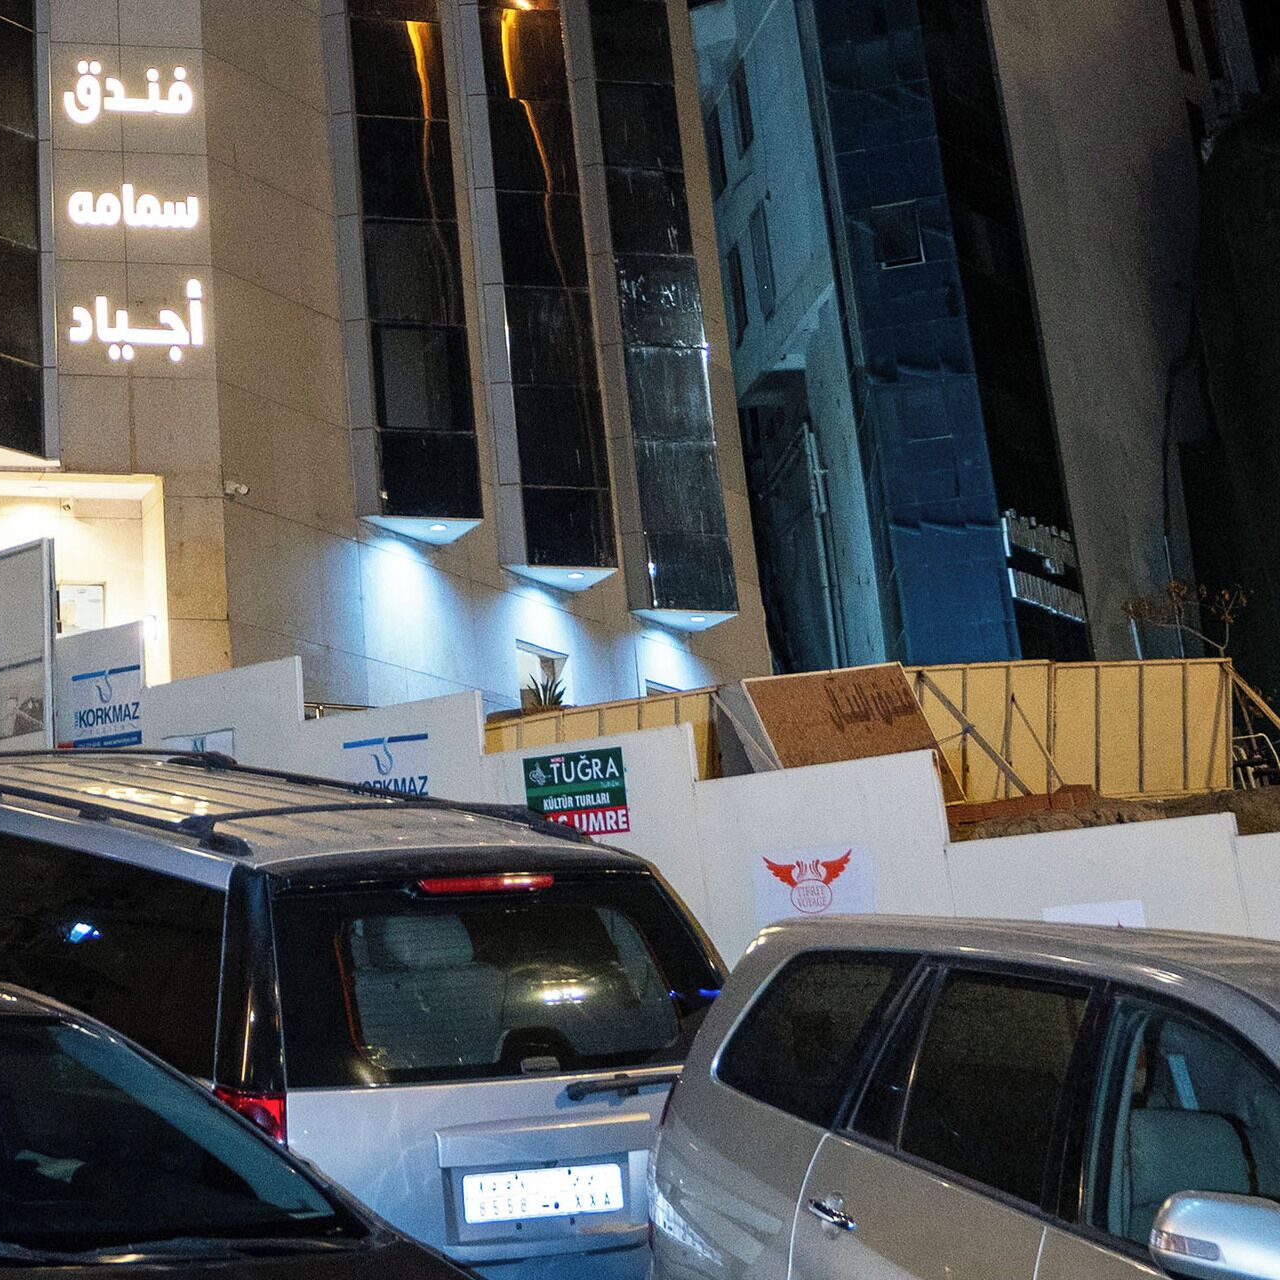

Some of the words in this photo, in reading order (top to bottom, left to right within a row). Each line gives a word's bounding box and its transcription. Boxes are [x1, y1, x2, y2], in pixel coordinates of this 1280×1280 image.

[63, 60, 194, 124] فندق
[69, 278, 204, 363] أجياد
[78, 701, 140, 729] KORKMAZ
[550, 754, 620, 784] TUĞRA
[543, 795, 574, 811] KÜLTÜR
[574, 792, 610, 808] TURLARI
[574, 809, 628, 833] UMRE
